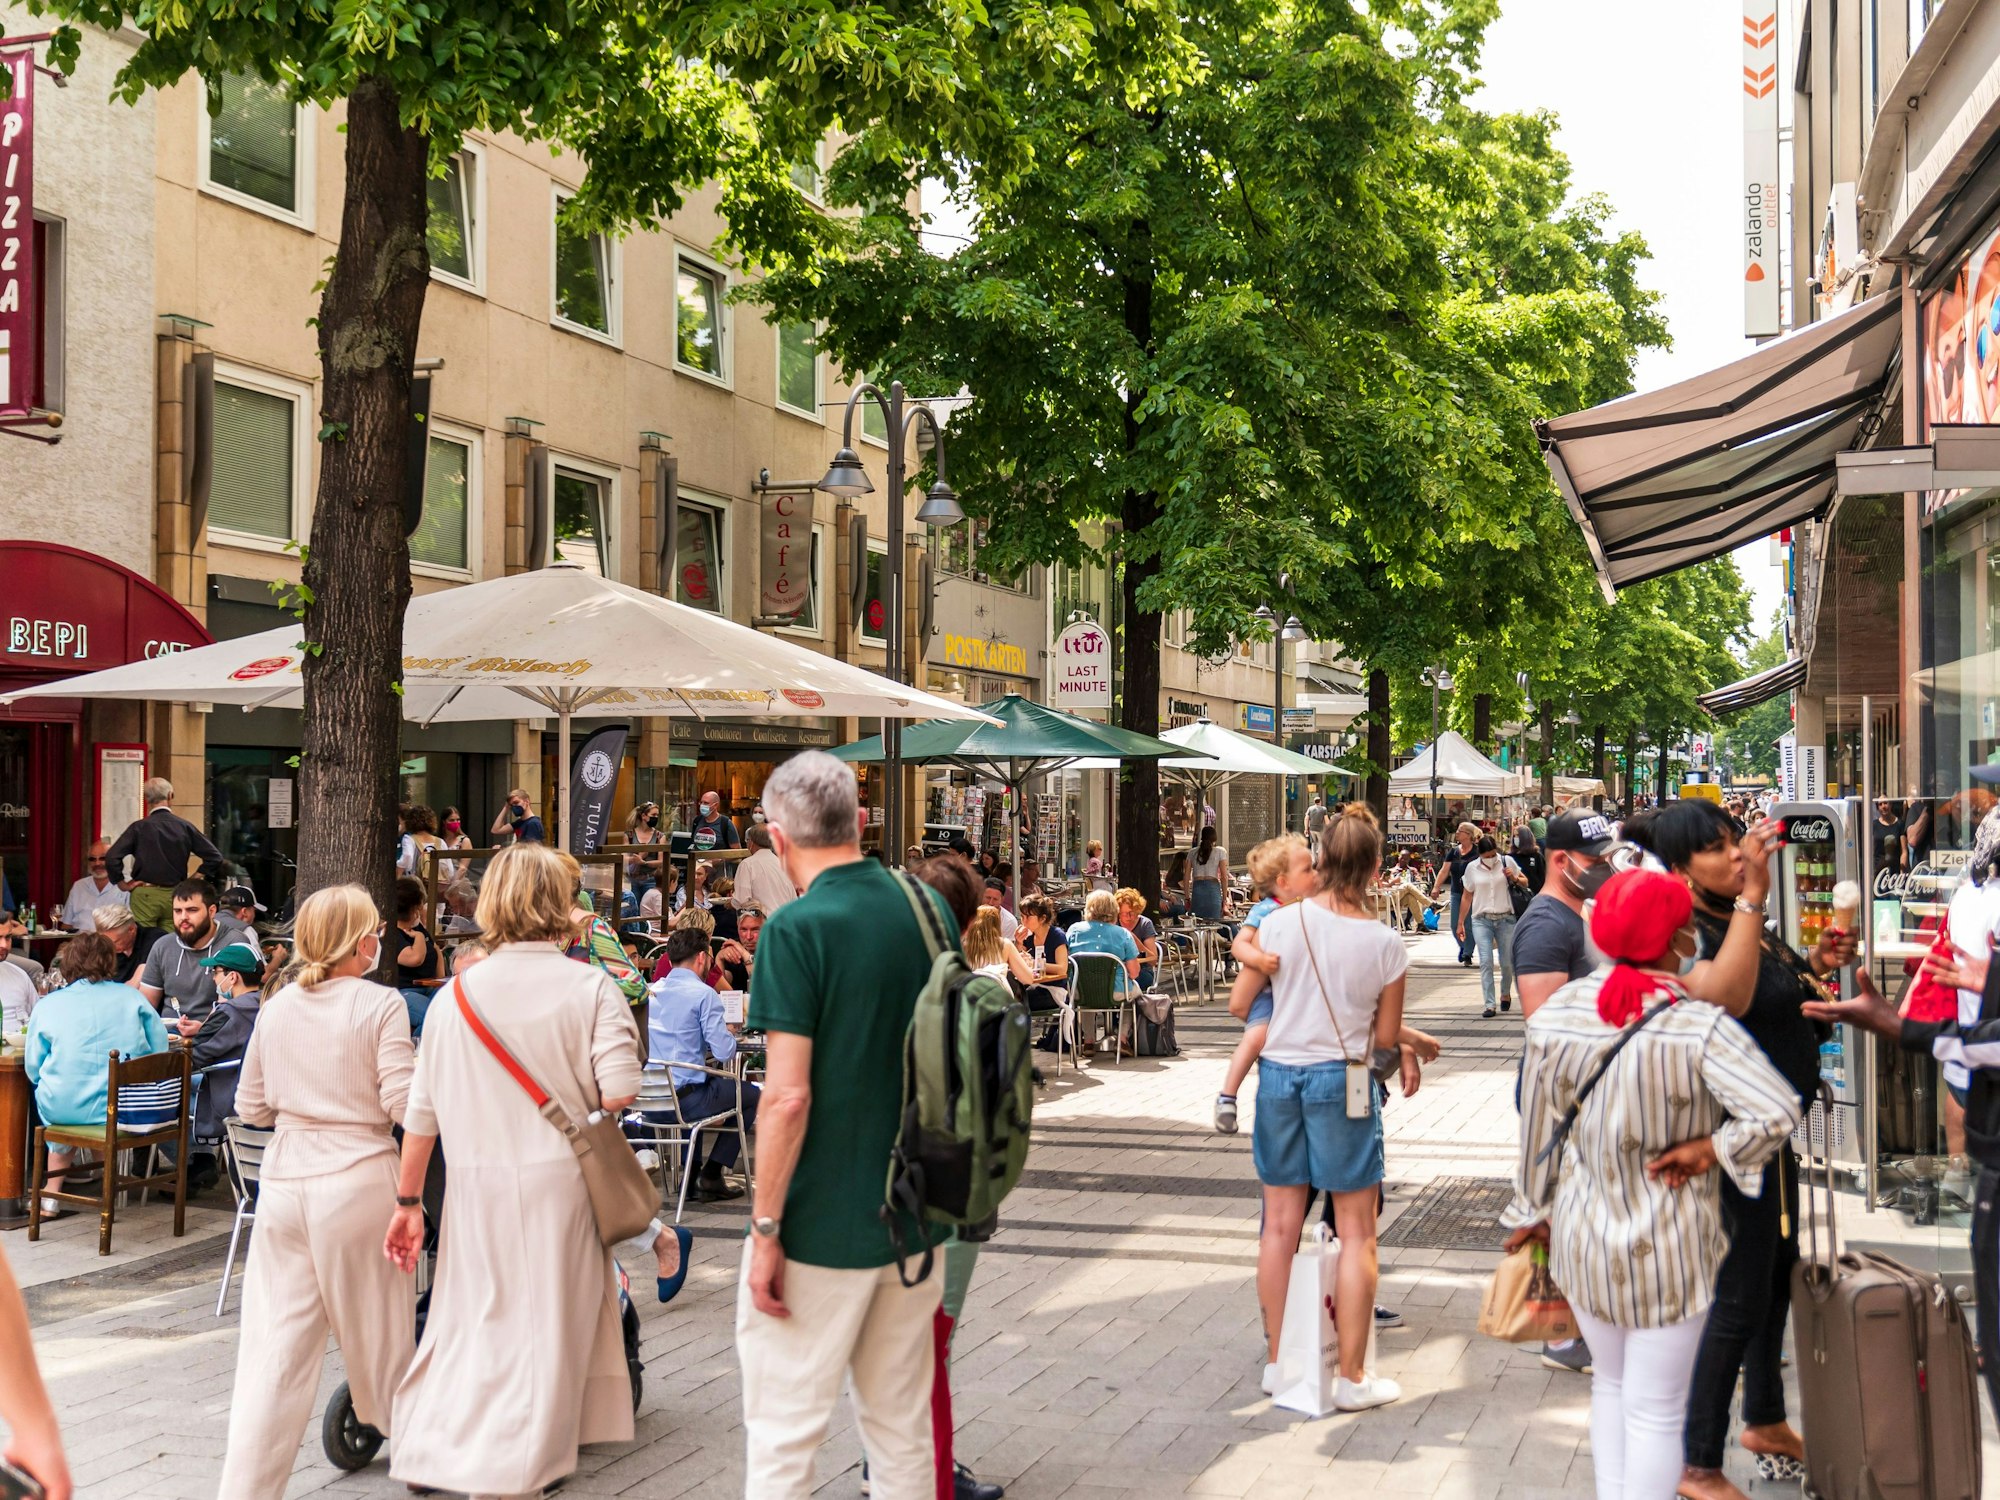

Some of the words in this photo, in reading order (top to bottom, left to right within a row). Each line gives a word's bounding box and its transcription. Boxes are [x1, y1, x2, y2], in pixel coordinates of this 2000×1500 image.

[0, 112, 23, 313] PIZZA
[1745, 183, 1762, 258] zalando
[1763, 183, 1777, 229] outlet
[776, 496, 794, 594] Café
[7, 617, 88, 659] BEPI
[945, 632, 1028, 675] POSTKARTEN
[1059, 681, 1108, 693] MINUTE
[1067, 665, 1099, 677] LAST
[703, 725, 742, 742] Conditorei
[753, 727, 788, 743] Confiserie
[798, 730, 831, 745] Restaurant
[1304, 744, 1350, 760] KARSTAD
[1807, 748, 1815, 800] TESTZENTRUM
[1790, 820, 1831, 839] Coca-Cola
